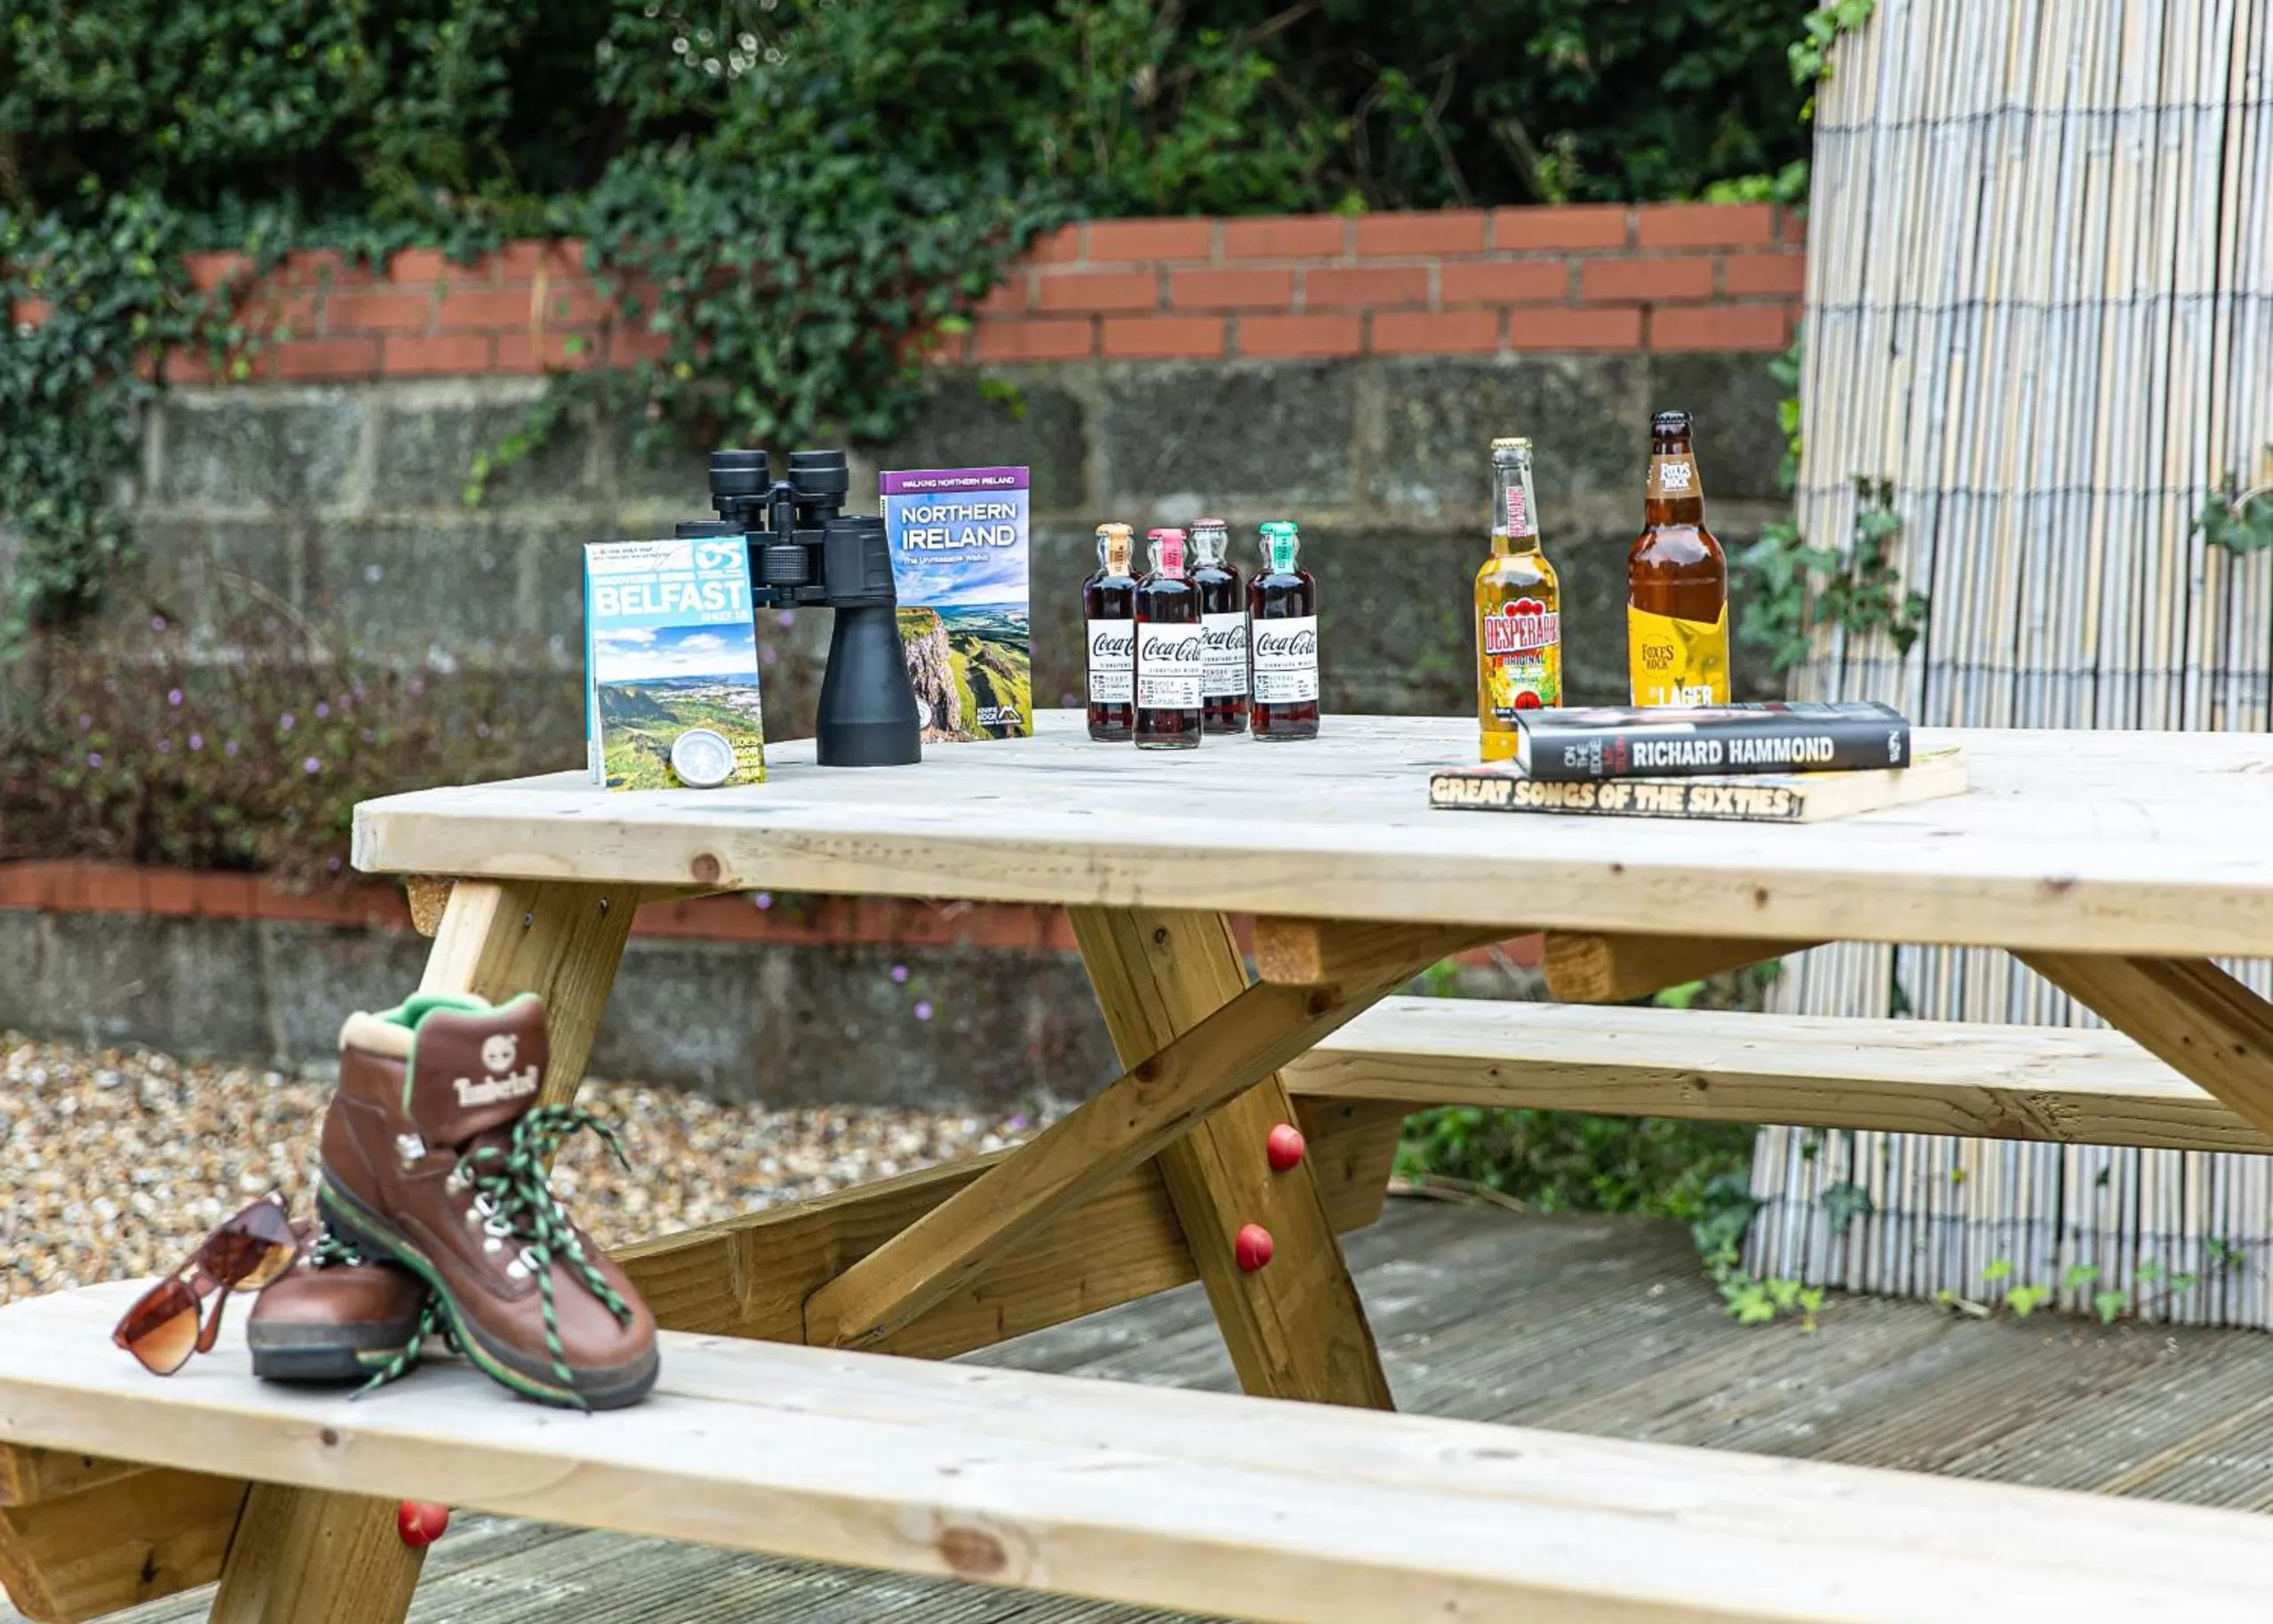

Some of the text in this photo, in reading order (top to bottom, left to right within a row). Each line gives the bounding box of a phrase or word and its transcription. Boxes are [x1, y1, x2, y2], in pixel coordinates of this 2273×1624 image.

[937, 478, 979, 487] NORTHERN
[981, 476, 1015, 485] IRELAND
[901, 503, 1017, 524] NORTHERN
[902, 525, 1016, 550] IRELAND
[595, 580, 746, 617] BELFAST
[1503, 654, 1545, 666] ORIGINAL
[1642, 644, 1674, 661] FOXES
[1647, 659, 1669, 670] ROCK
[1659, 685, 1712, 706] LAGER
[1564, 745, 1575, 766] ON
[1576, 742, 1589, 768] THE
[1589, 736, 1602, 775] EDGE
[1633, 736, 1834, 767] RICHARD HAMMOND
[1432, 777, 1511, 803] GREAT
[1514, 780, 1596, 808] SONGS
[1599, 783, 1631, 809] OF
[1635, 784, 1685, 811] THE
[1689, 786, 1790, 816] SIXTIES
